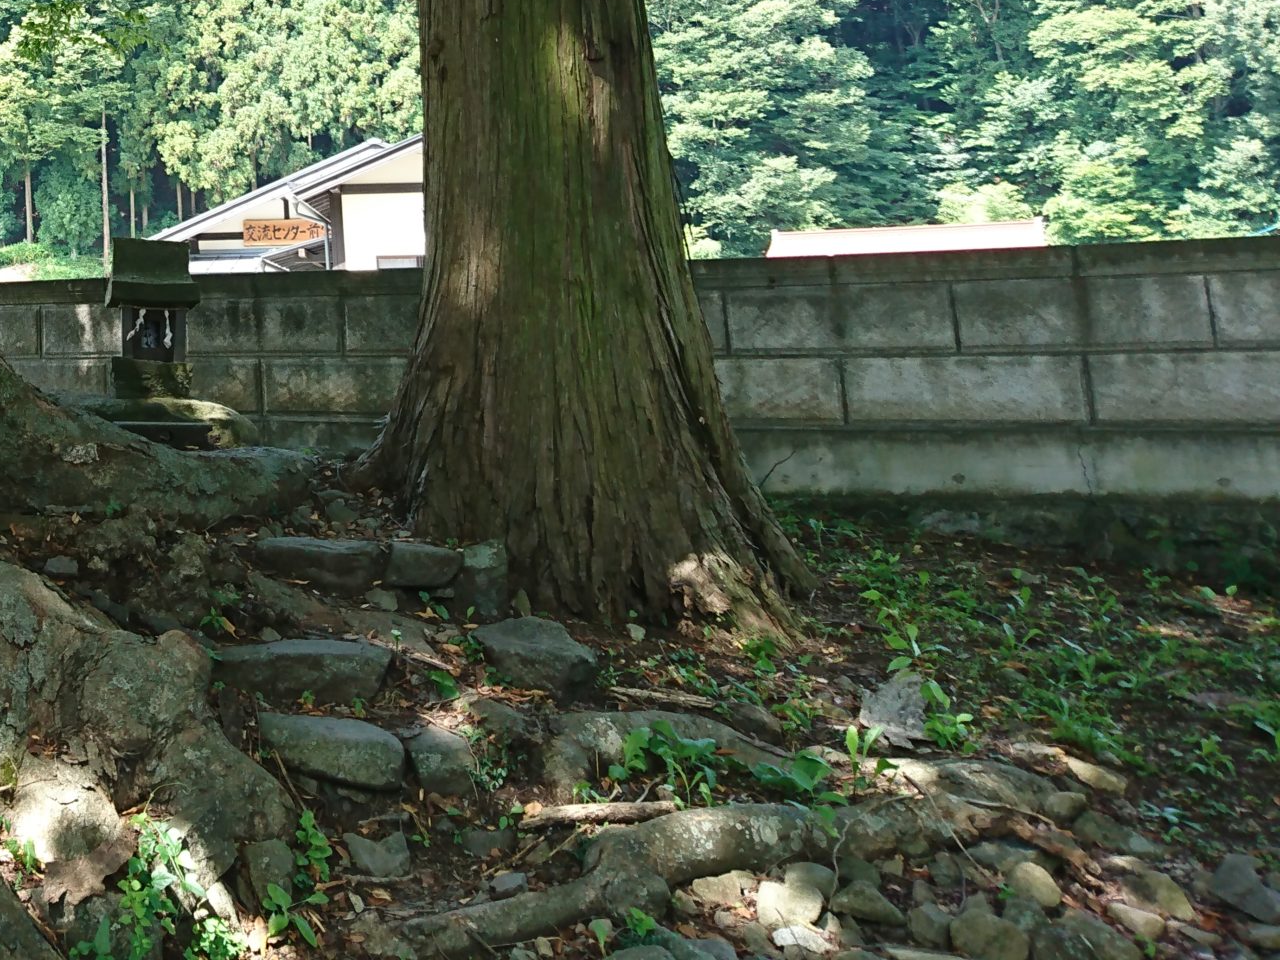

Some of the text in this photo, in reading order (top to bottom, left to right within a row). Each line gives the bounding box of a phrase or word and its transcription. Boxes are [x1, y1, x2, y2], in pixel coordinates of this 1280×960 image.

[245, 223, 324, 242] 交流センター前
